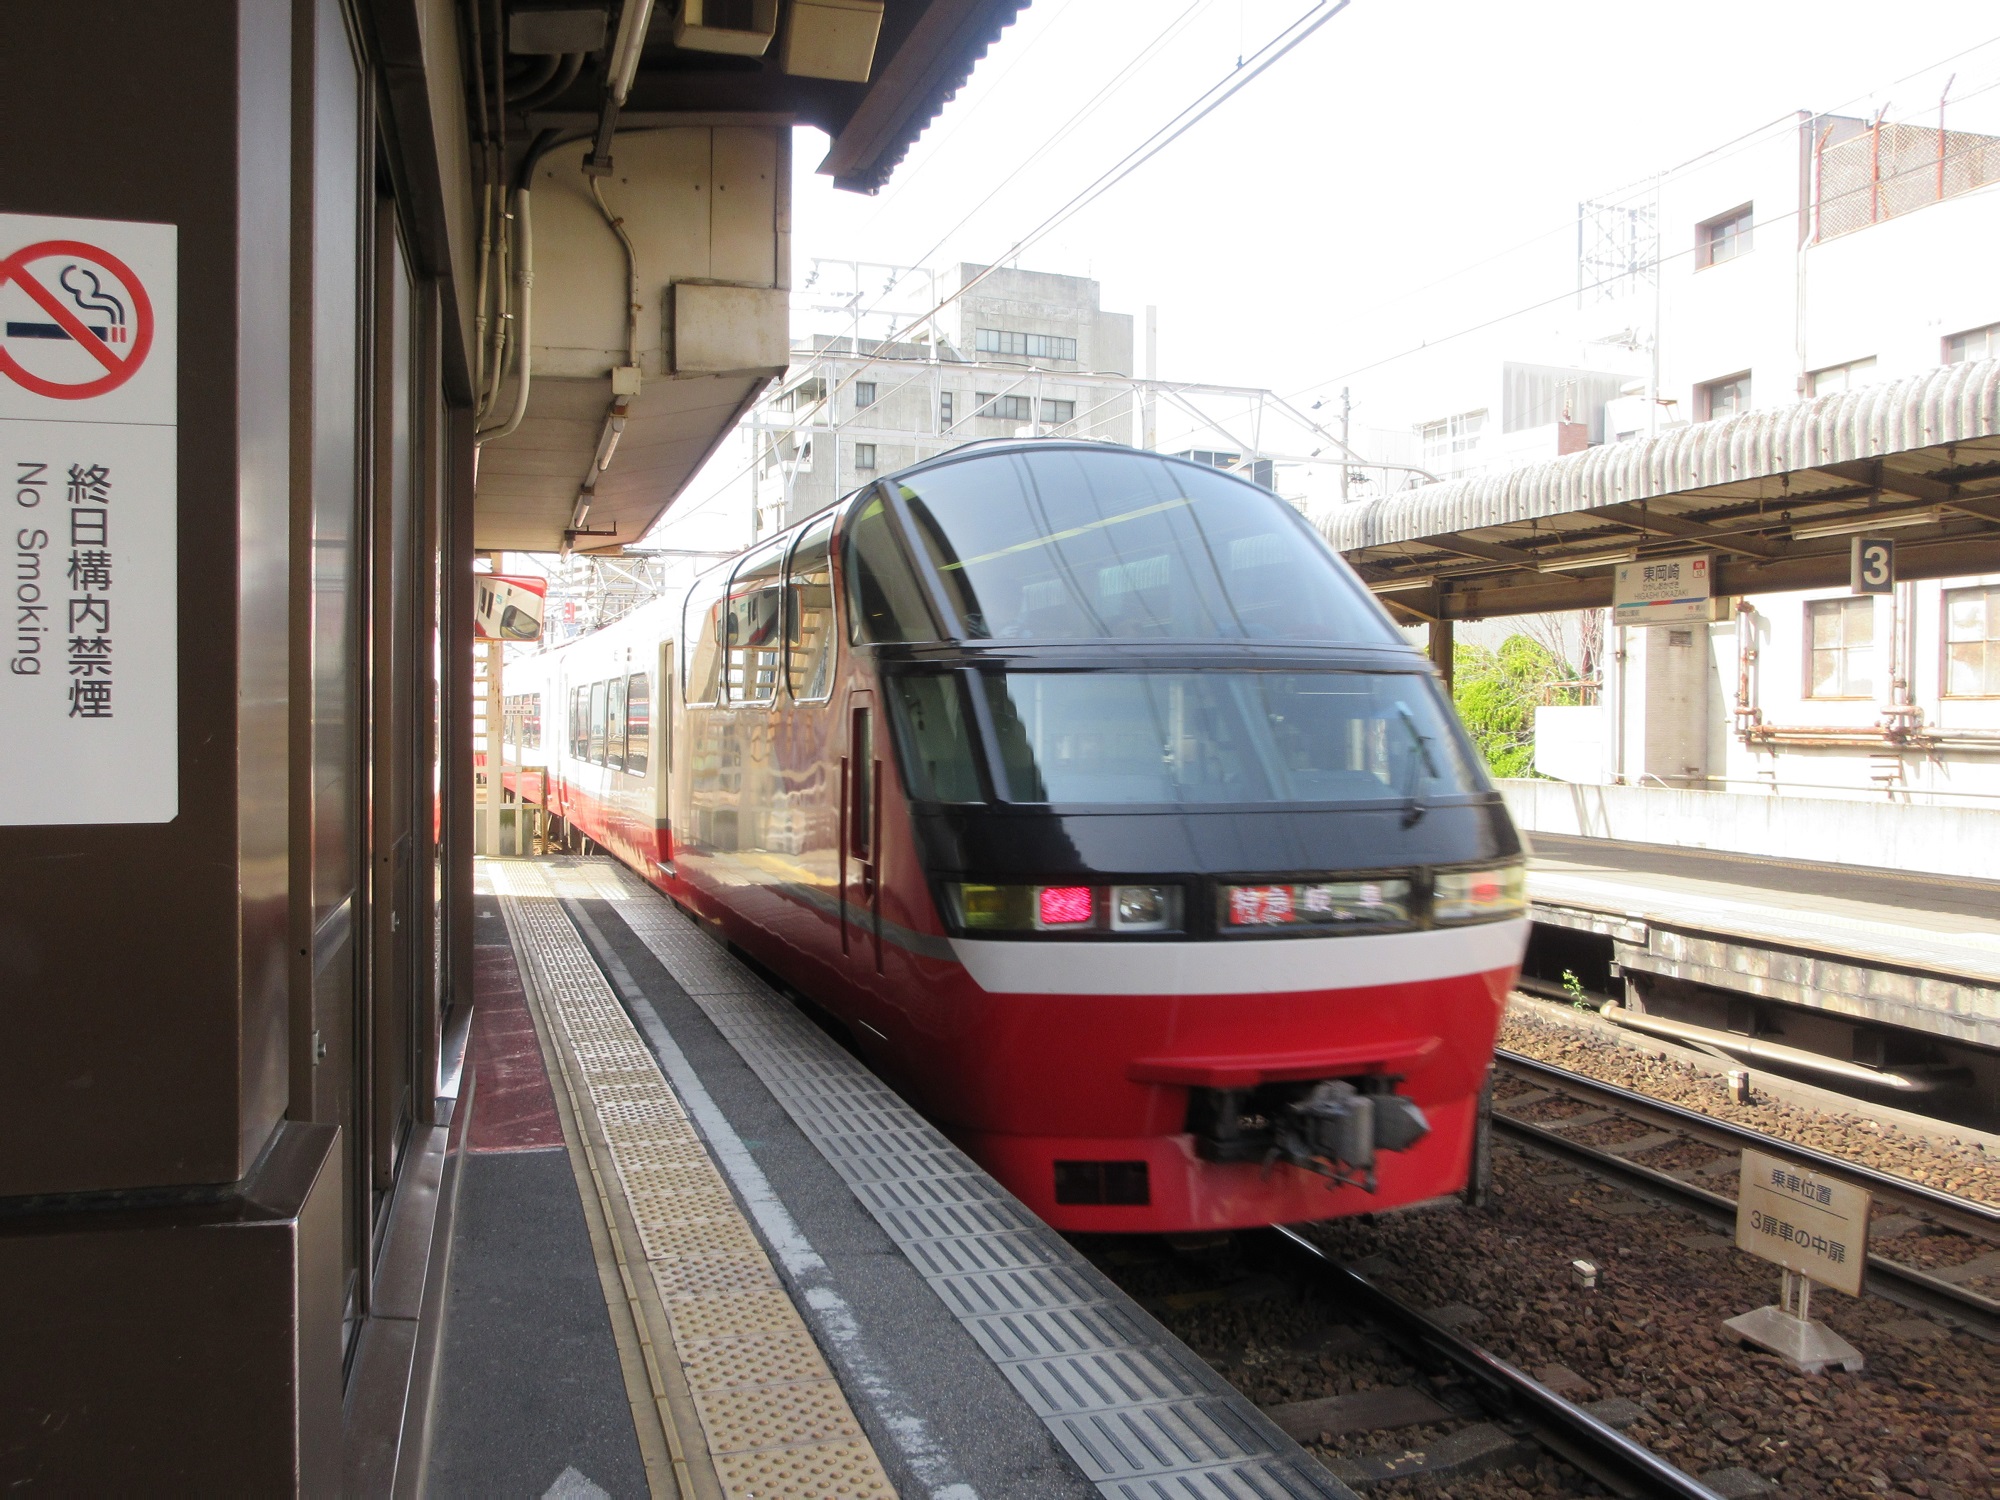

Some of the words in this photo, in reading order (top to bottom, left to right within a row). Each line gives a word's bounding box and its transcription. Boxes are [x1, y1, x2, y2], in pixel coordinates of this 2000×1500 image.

[17, 462, 48, 508] No
[1643, 563, 1680, 583] 東岡崎
[1863, 546, 1889, 585] 3
[11, 529, 48, 676] Smoking
[67, 463, 113, 718] 終日構内禁煙
[1634, 590, 1660, 600] HIGASHI
[1660, 589, 1689, 599] OKAZAKI
[1771, 1168, 1832, 1206] 乗車位置
[1750, 1209, 1846, 1264] 3扉車の中扉
